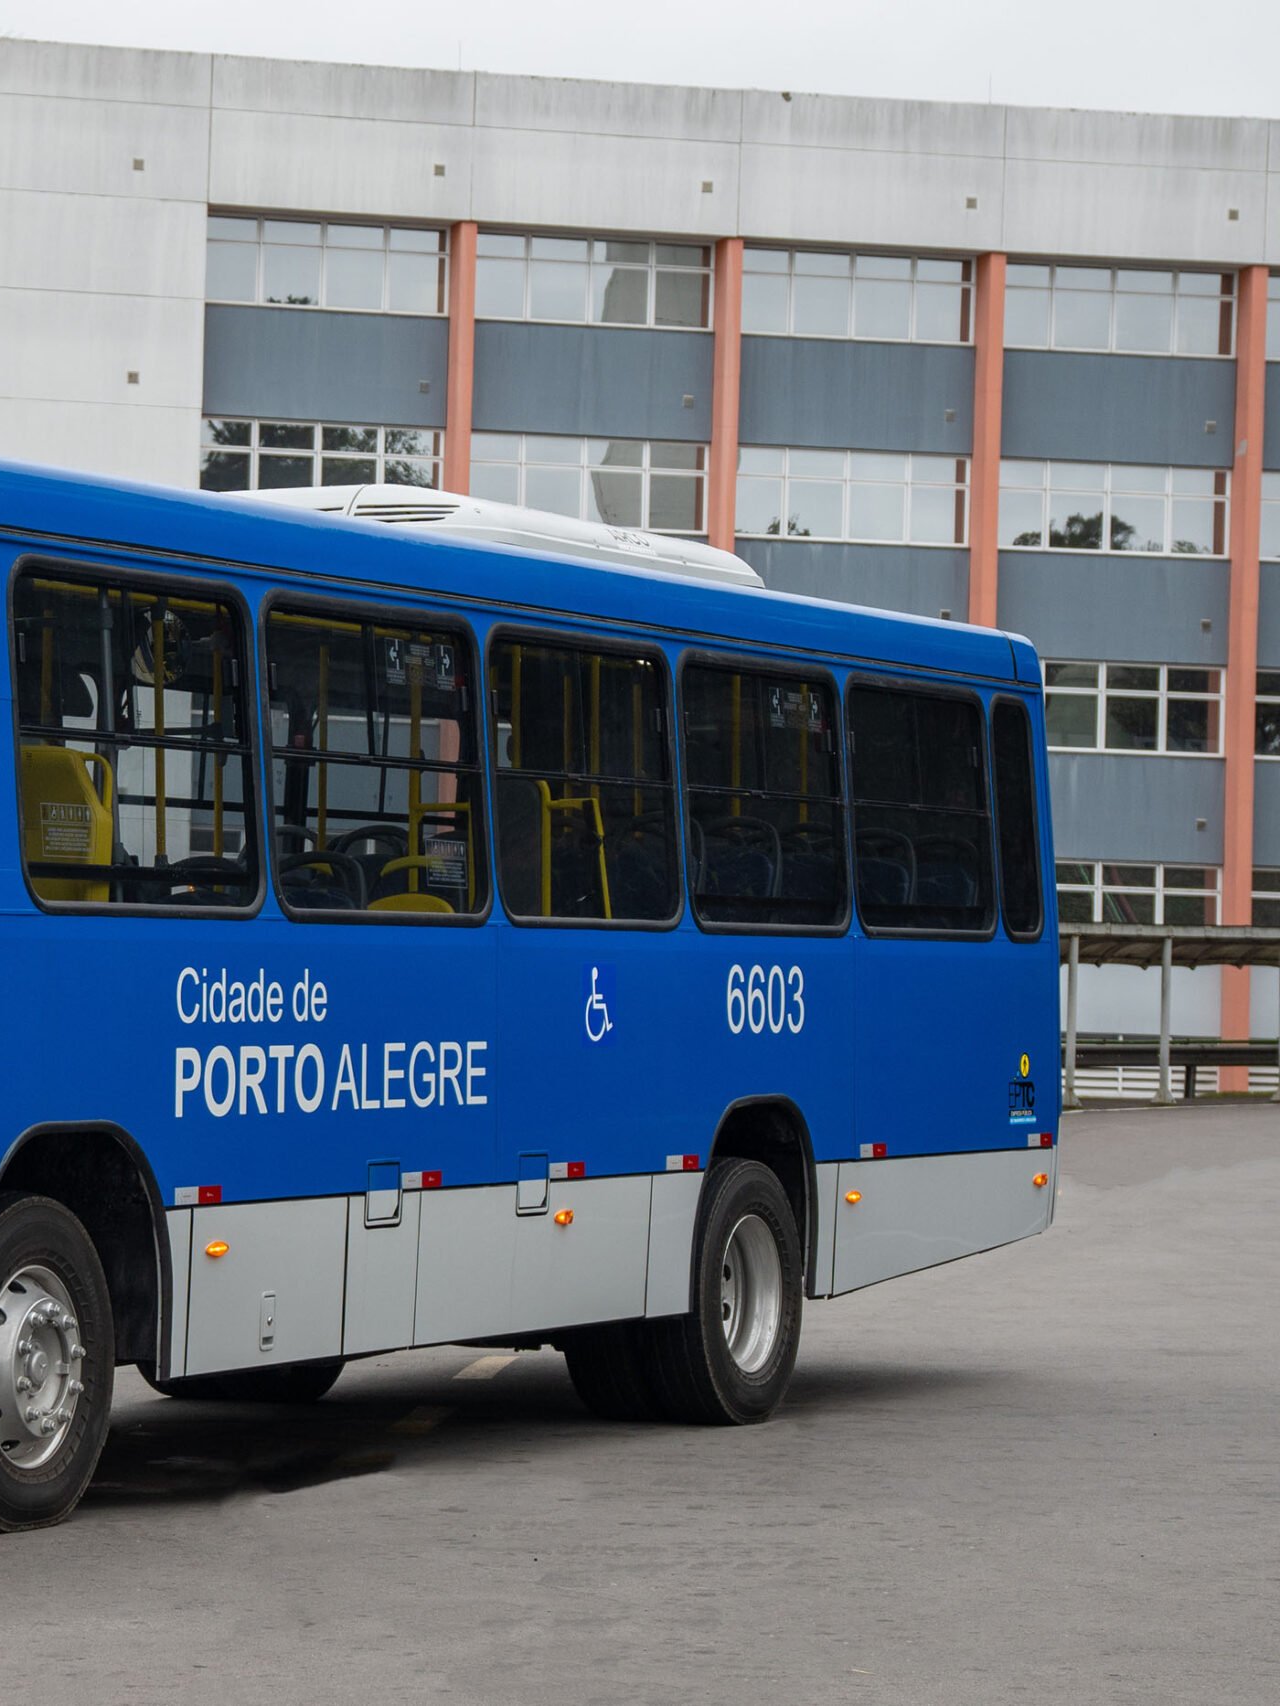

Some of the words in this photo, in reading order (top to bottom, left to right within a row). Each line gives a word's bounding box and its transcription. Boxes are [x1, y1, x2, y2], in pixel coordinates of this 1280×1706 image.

[176, 967, 284, 1024] Cidade
[292, 968, 328, 1022] de
[727, 964, 805, 1034] 6603
[175, 1043, 325, 1118] PORTO
[331, 1041, 488, 1111] ALEGRE
